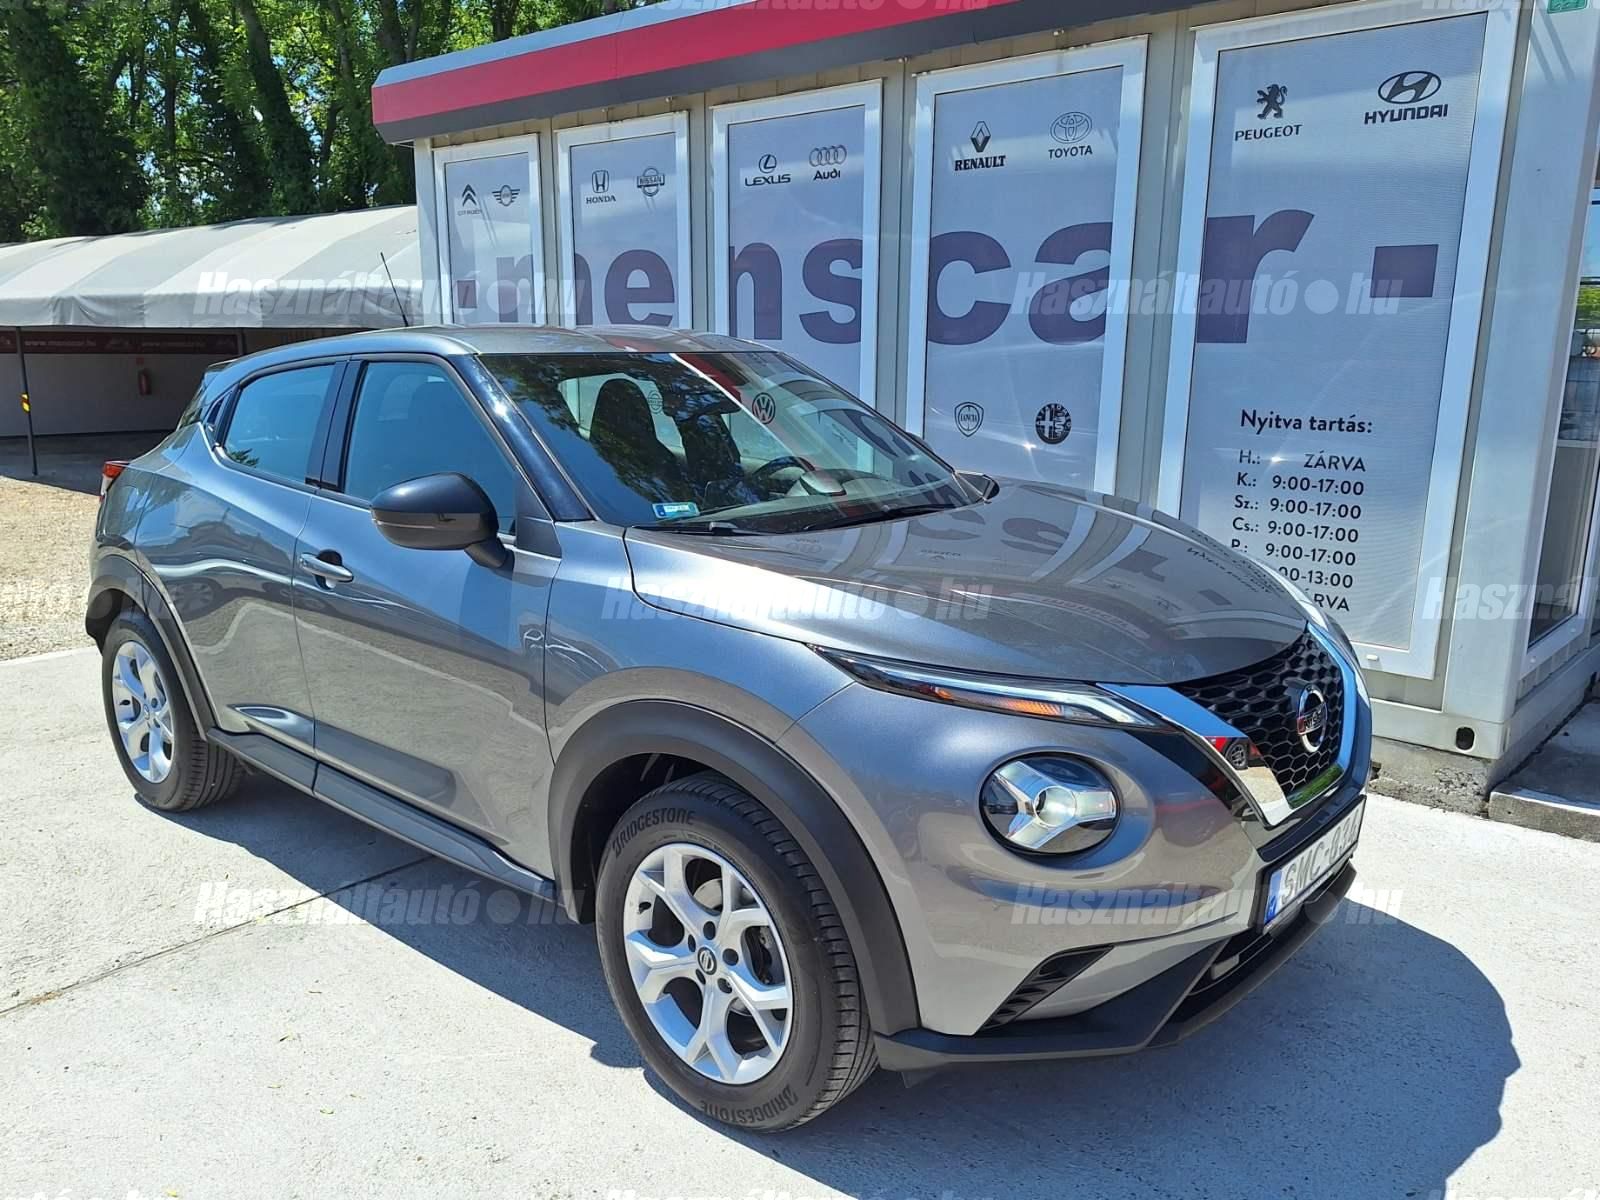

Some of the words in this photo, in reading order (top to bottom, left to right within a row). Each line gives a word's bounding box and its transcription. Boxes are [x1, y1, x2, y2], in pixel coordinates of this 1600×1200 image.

[1364, 104, 1448, 125] HYUNDAI
[1234, 124, 1303, 141] PEUGEOT
[954, 155, 1006, 171] RENAULT
[1048, 145, 1093, 159] TOYOTA
[744, 173, 791, 187] LEXUS
[813, 168, 841, 181] Audi
[586, 195, 616, 205] HONDA
[1240, 409, 1302, 435] Nyitva
[1309, 414, 1373, 433] tartás:
[1239, 450, 1260, 465] H.:
[1304, 450, 1366, 472] ZÁRVA
[1236, 472, 1257, 487] K.:
[1272, 475, 1364, 496] 9:00-17:00
[1234, 495, 1259, 510] Sz.:
[1270, 498, 1361, 519] 9:00-17:00
[1232, 517, 1259, 533] Cs.:
[1267, 521, 1359, 543] 9:00-17:00
[1265, 543, 1356, 566] 9:00-17:00
[612, 807, 697, 858] BRIDGESTONE
[700, 1083, 799, 1124] BRIDGESTONE
